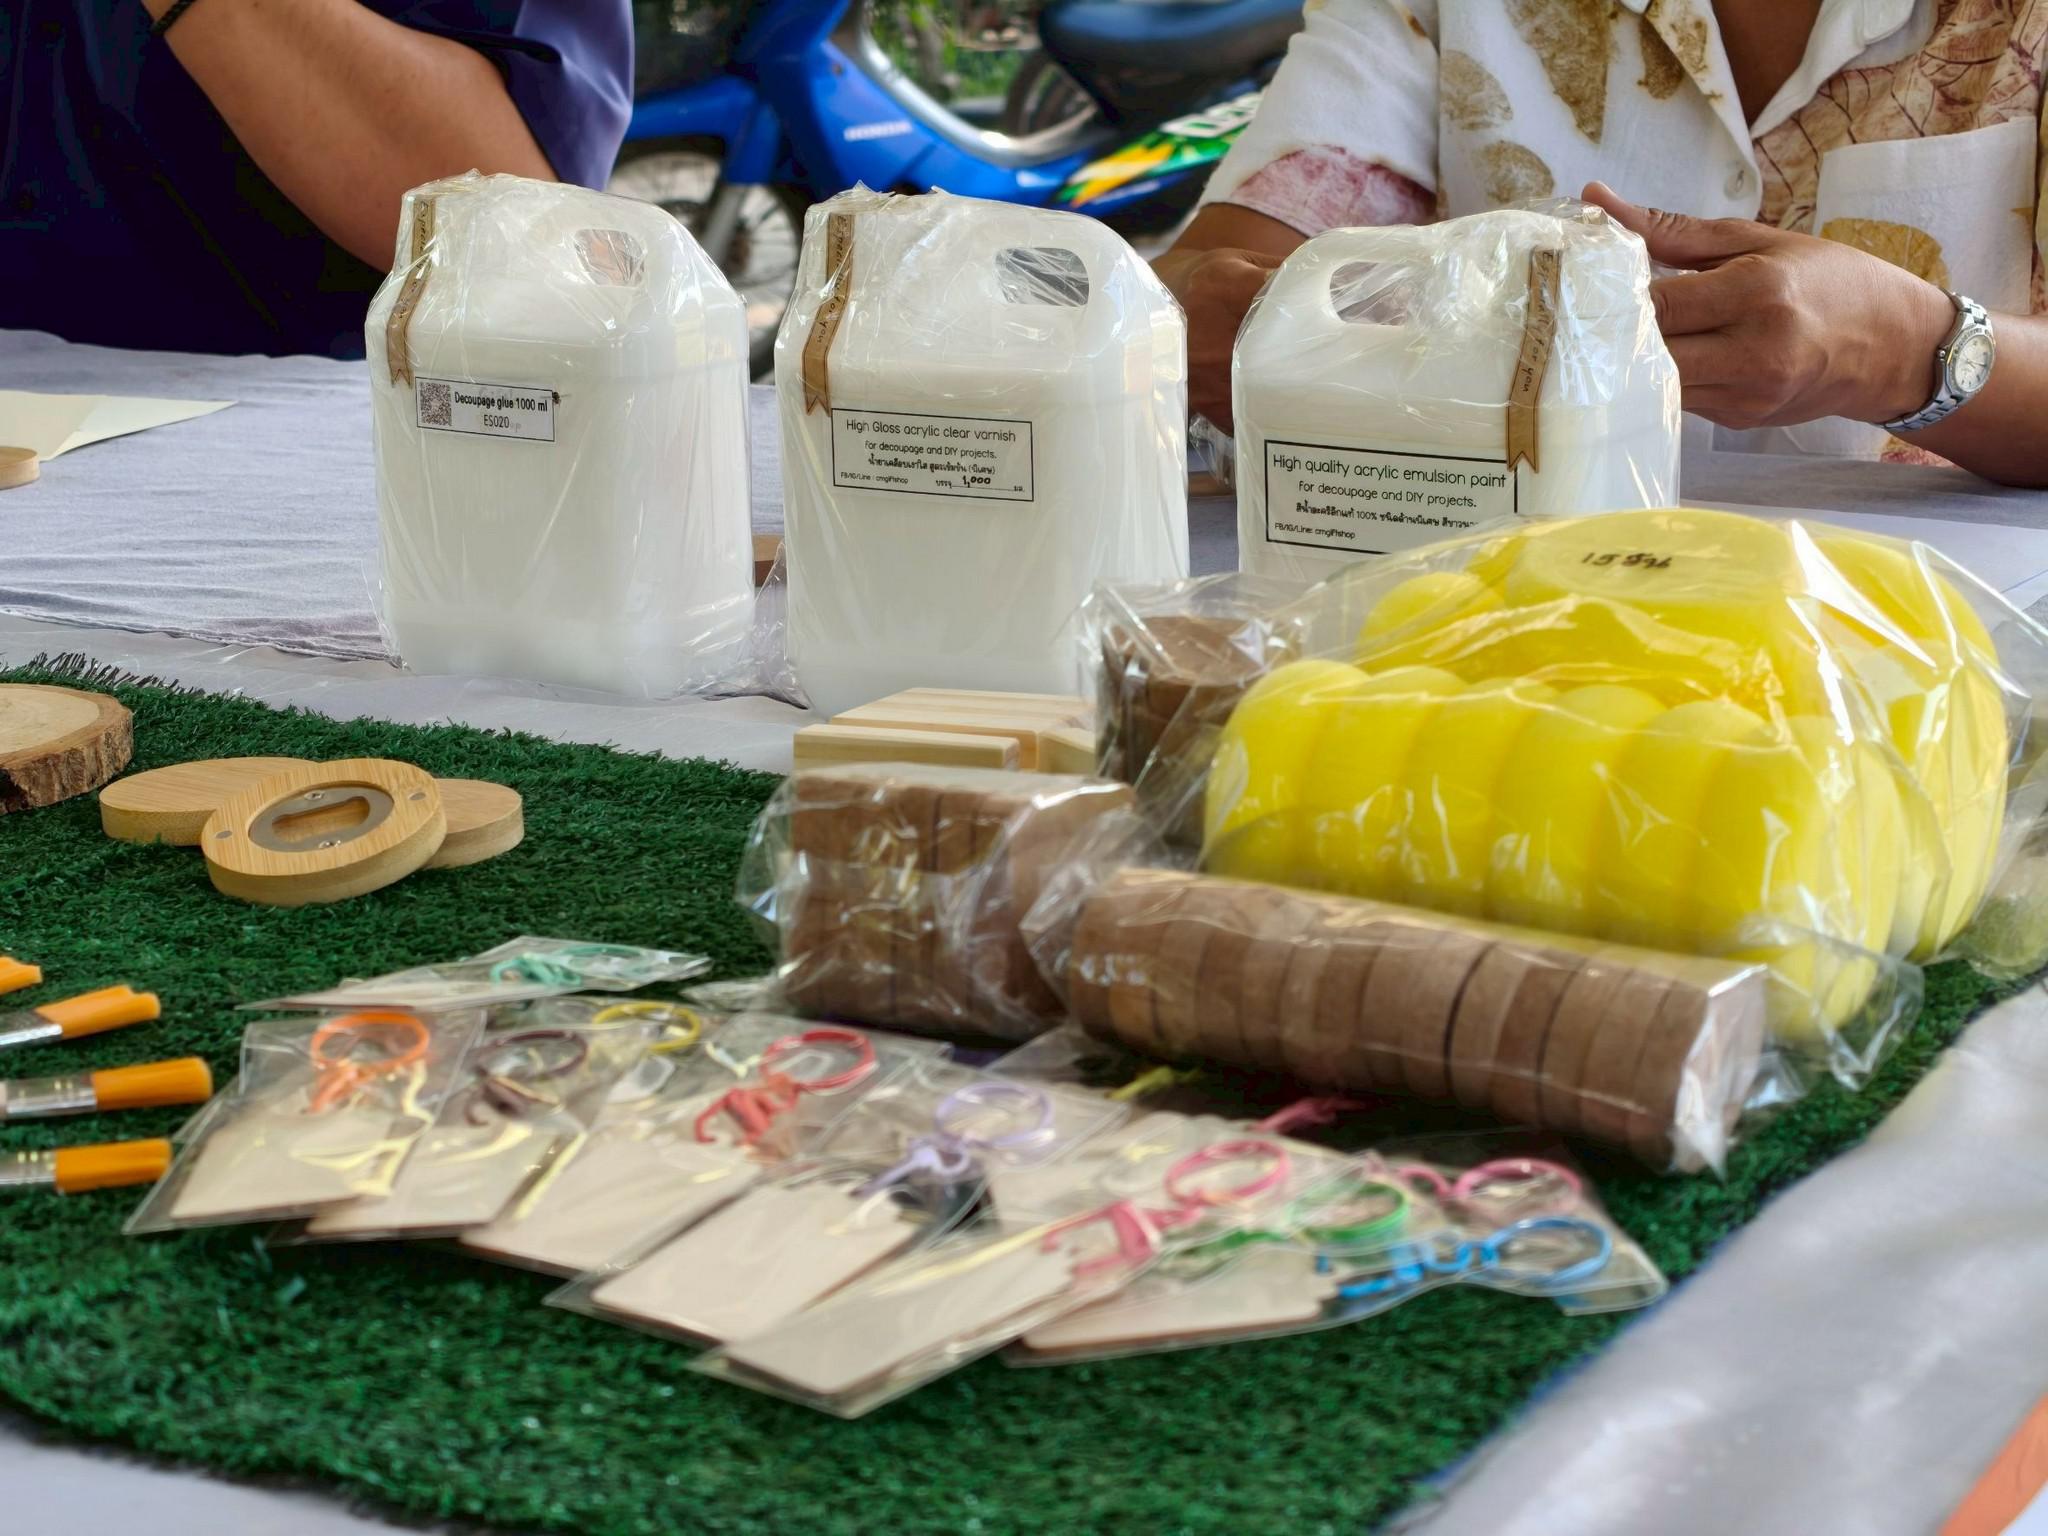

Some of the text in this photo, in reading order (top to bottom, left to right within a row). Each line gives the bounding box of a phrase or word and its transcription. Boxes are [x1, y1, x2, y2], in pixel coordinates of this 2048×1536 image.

[1522, 367, 1534, 392] you
[454, 391, 548, 411] Decoupage glue 1000 ml
[483, 414, 510, 428] ES020
[846, 419, 1016, 442] High Gloss acrylic clear varnish
[879, 442, 924, 455] decoupage
[926, 446, 942, 455] and
[944, 446, 958, 455] DIY
[960, 449, 997, 459] projects.
[962, 475, 992, 488] 1,000
[1272, 454, 1506, 488] High quality acrylic emulsion paint
[1318, 483, 1378, 500] decoupage
[1381, 490, 1403, 501] and
[1406, 491, 1424, 503] DIY
[1427, 496, 1477, 508] projects.
